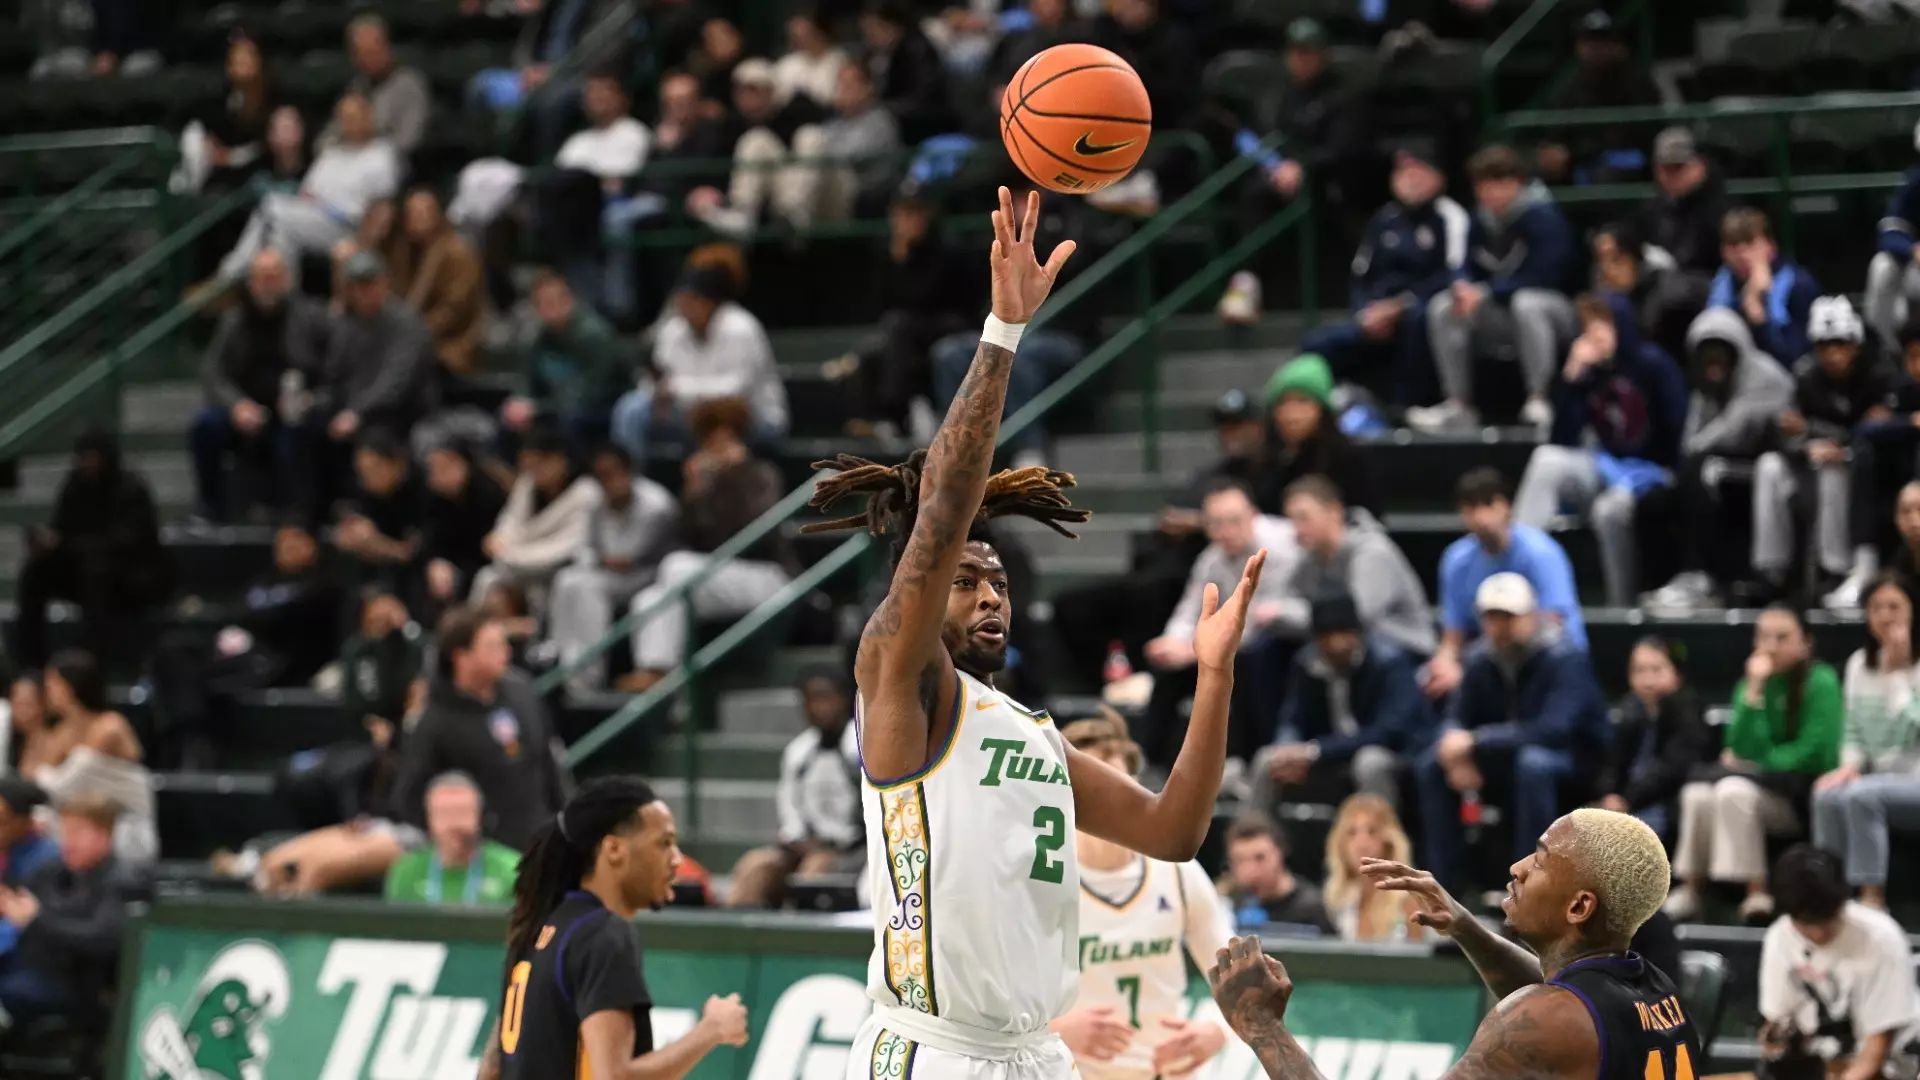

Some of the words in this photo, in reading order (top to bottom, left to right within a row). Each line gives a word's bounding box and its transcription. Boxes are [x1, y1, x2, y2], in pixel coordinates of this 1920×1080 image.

[979, 737, 1073, 787] TULA
[1029, 805, 1066, 884] 2
[1117, 975, 1142, 1030] 7
